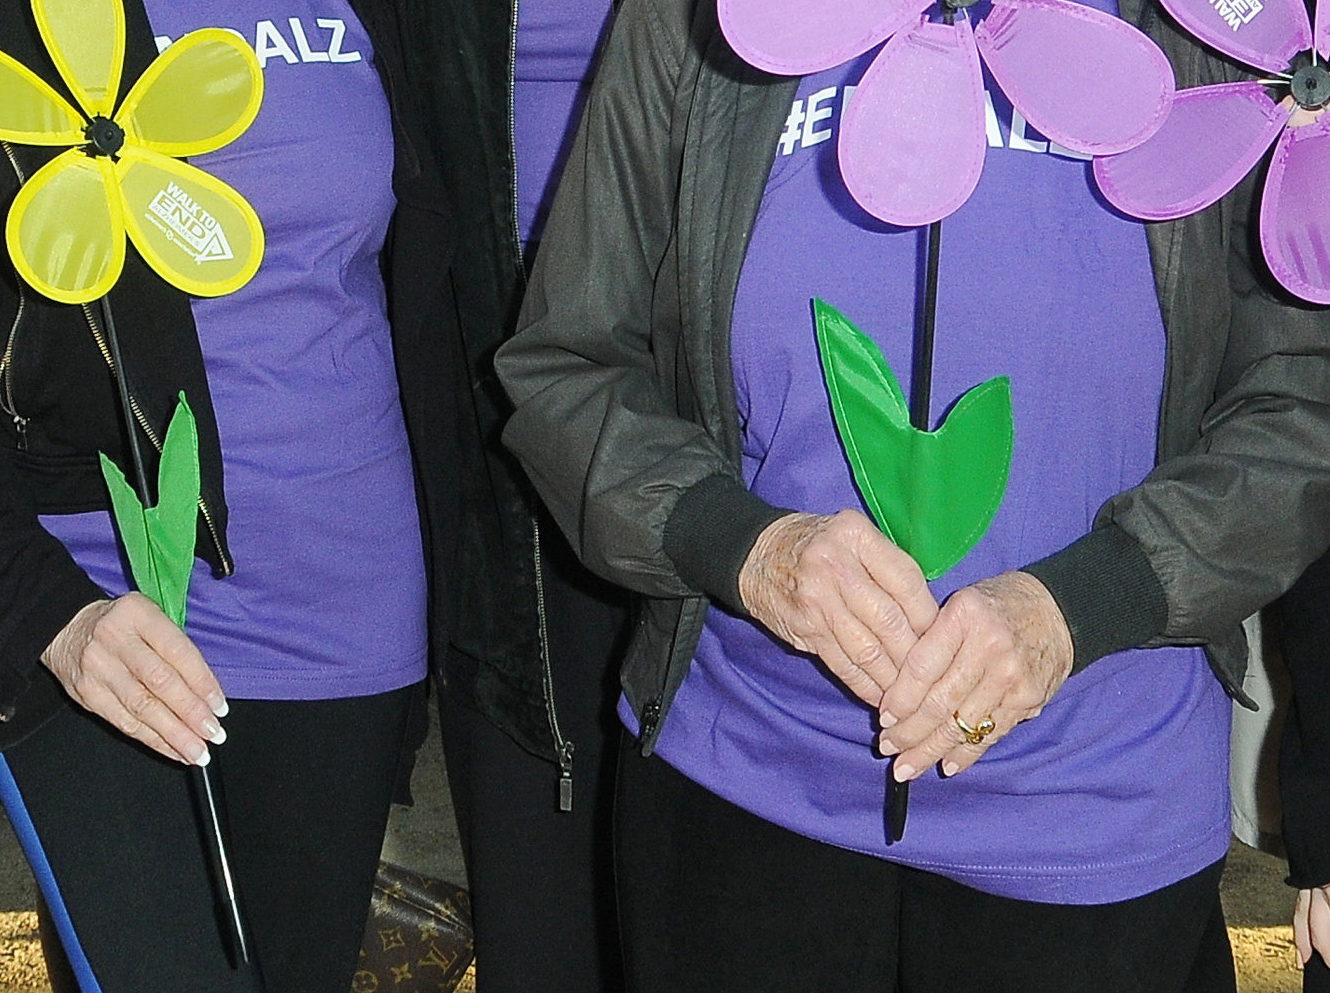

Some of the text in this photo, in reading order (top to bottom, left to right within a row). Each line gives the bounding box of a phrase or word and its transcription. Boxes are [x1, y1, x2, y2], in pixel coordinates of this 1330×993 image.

[157, 194, 206, 240] END
[166, 181, 217, 231] WALK TO
